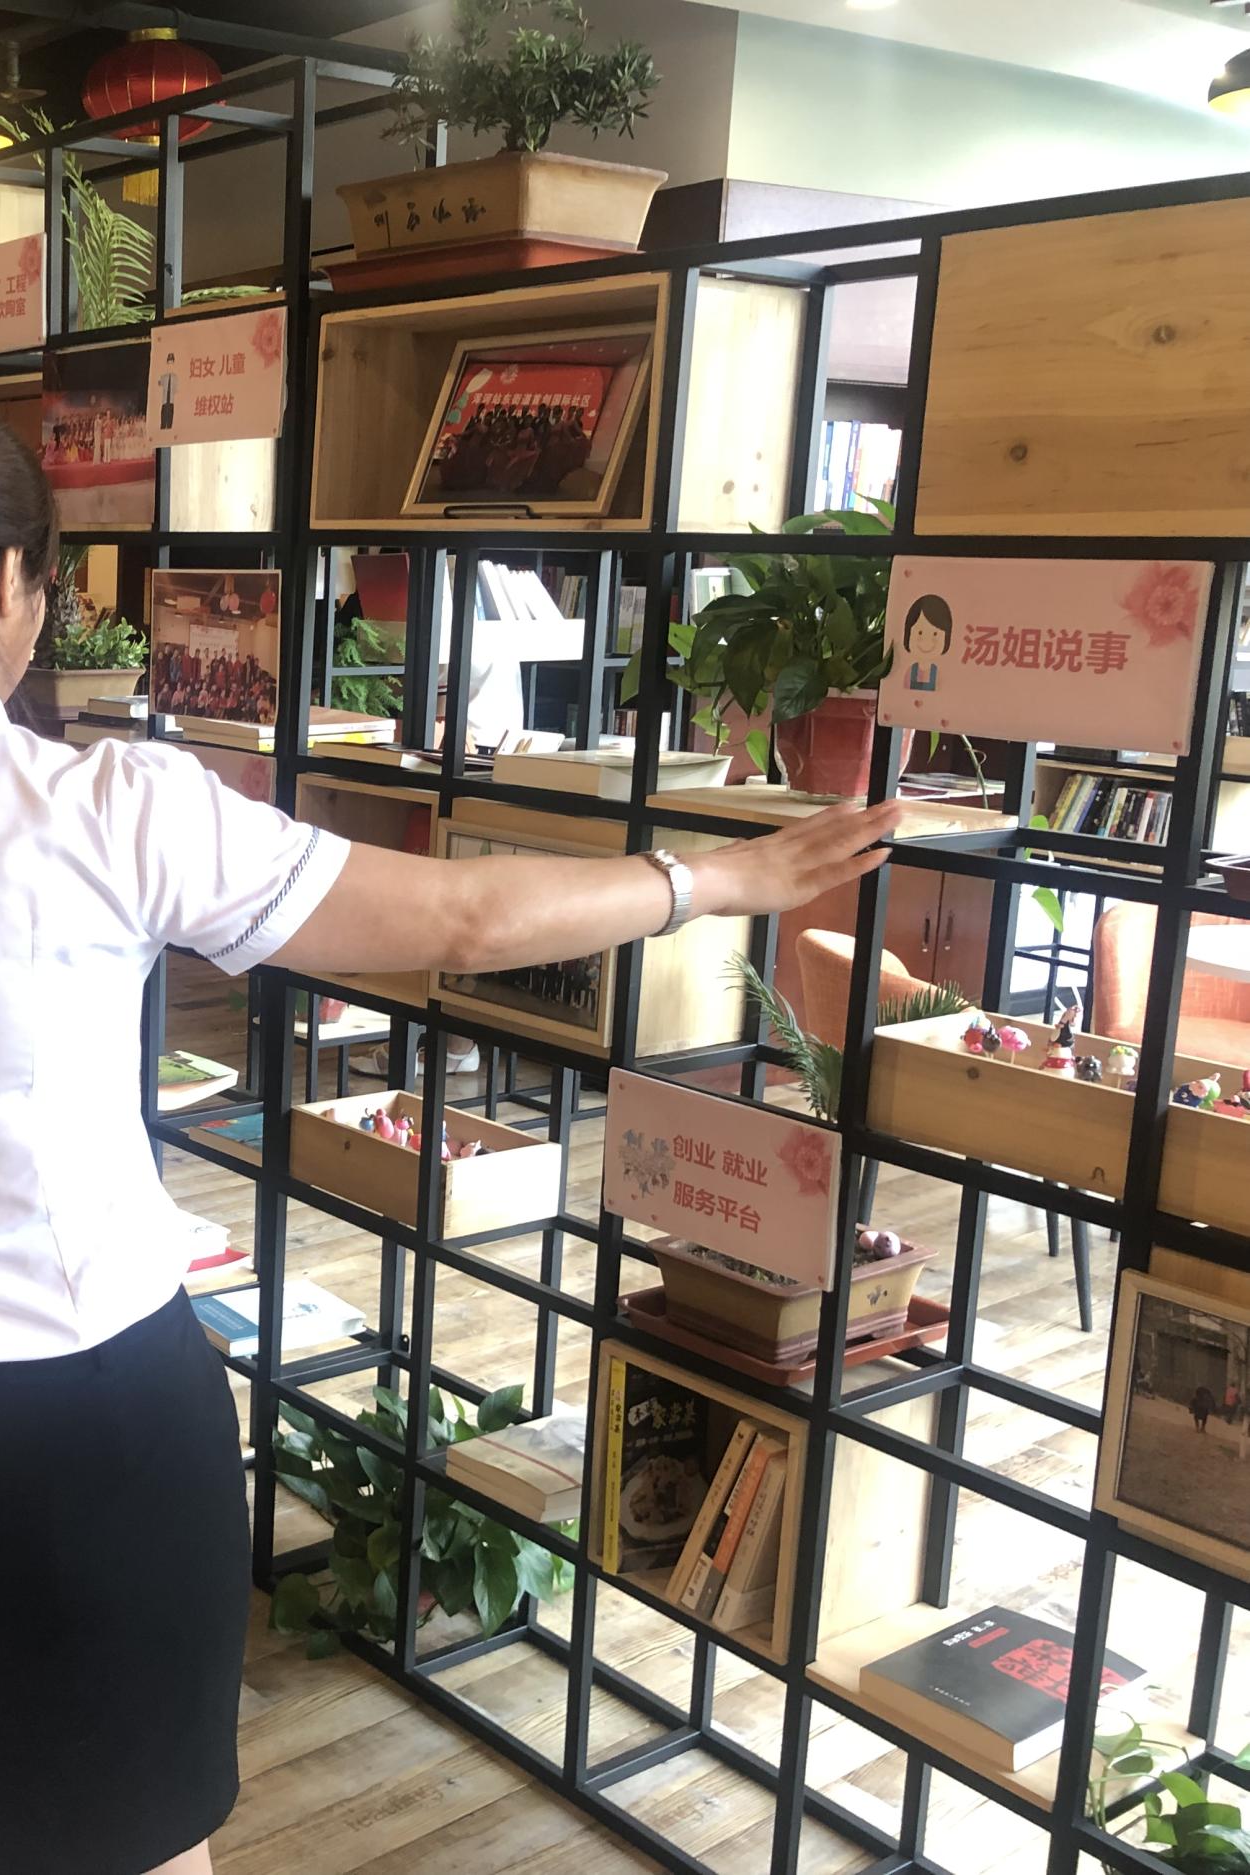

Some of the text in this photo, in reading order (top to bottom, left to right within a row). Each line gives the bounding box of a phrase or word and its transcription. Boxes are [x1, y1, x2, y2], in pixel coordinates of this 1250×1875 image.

[189, 352, 246, 379] 妇女 儿童
[194, 392, 235, 417] 维权站
[961, 623, 1132, 675] 汤姐说事
[673, 1134, 768, 1187] 创业 就业
[673, 1180, 761, 1234] 服务平台
